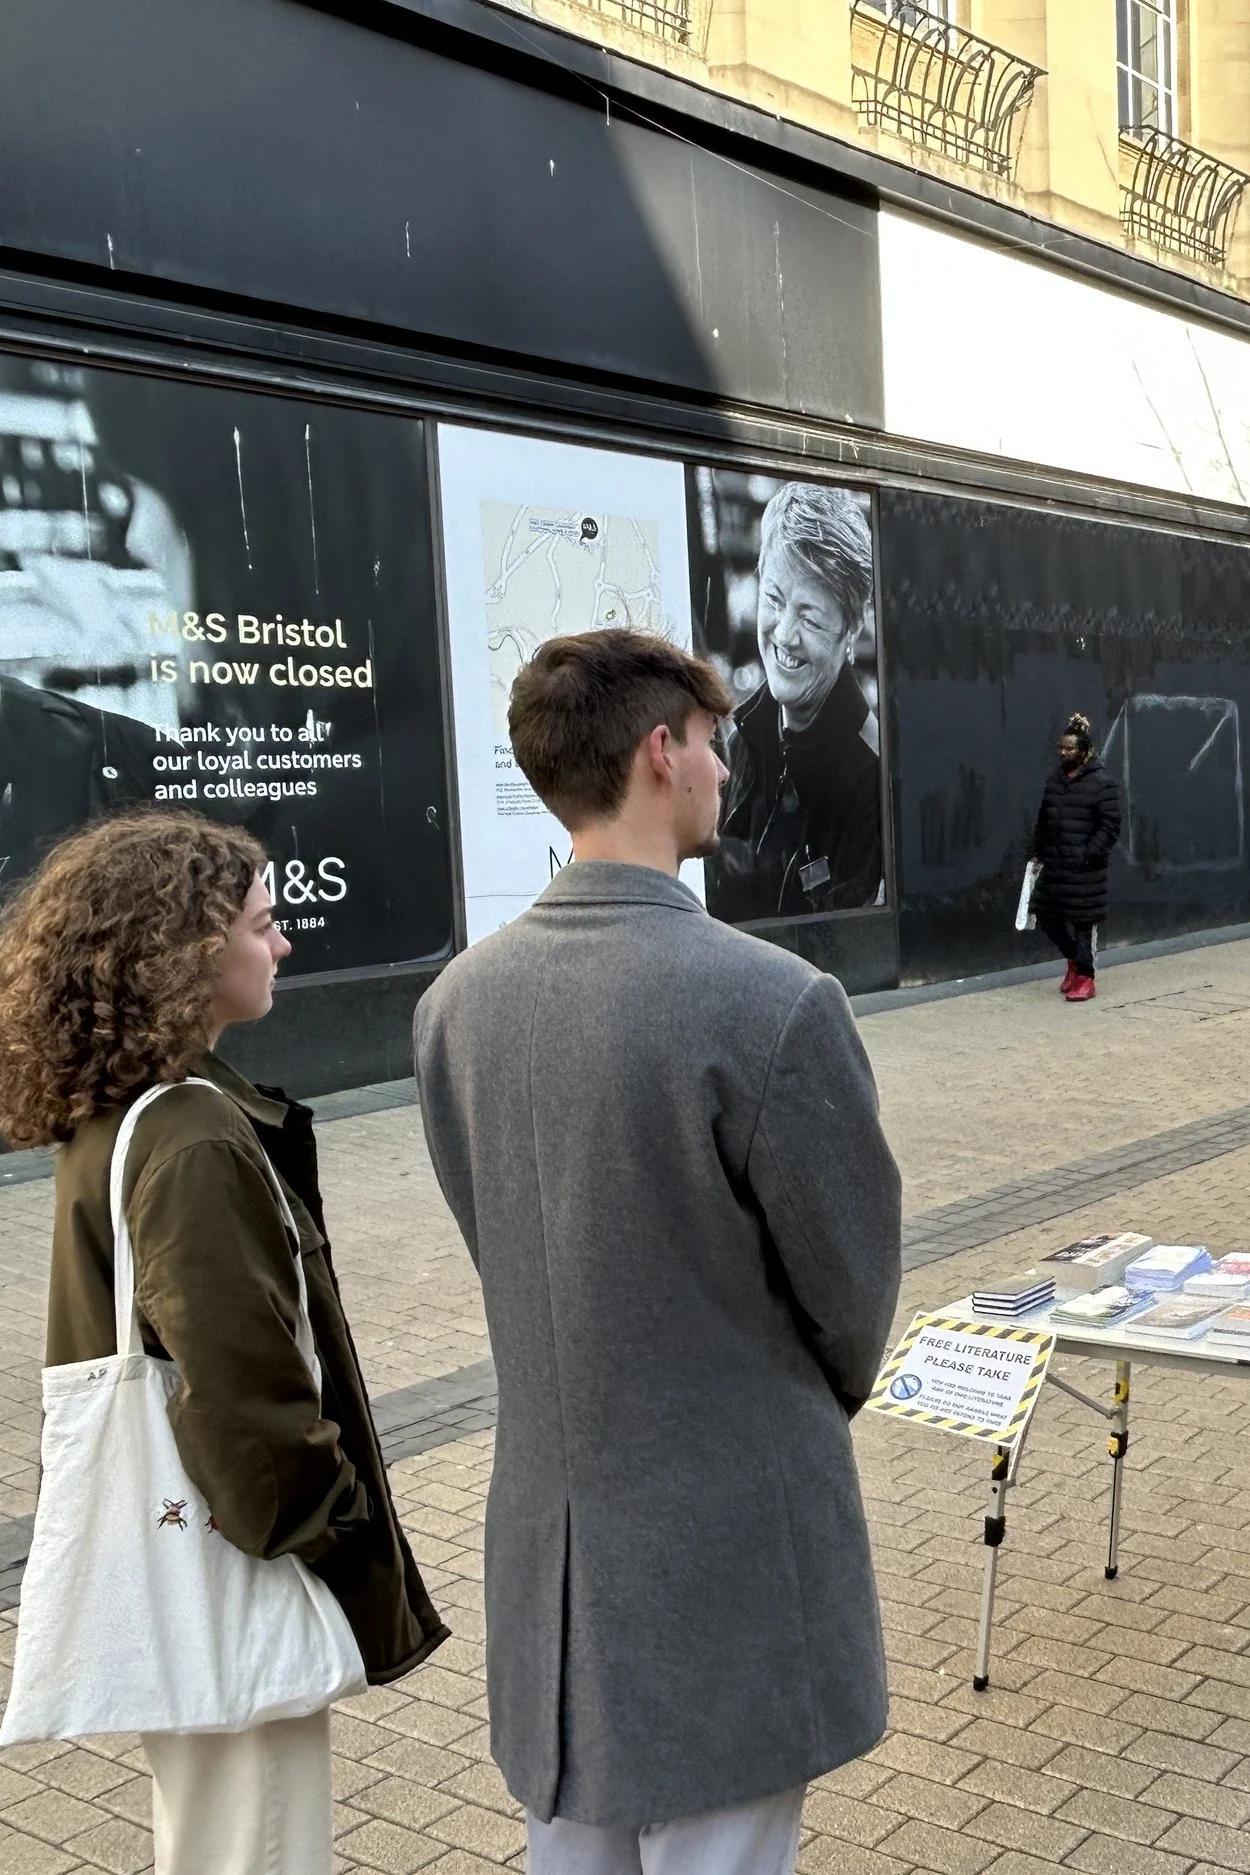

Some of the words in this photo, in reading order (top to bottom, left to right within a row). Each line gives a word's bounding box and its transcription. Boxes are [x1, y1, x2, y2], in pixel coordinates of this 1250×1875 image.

[150, 611, 227, 644] M&S
[237, 613, 348, 649] Bristol
[150, 652, 178, 683] is
[189, 660, 260, 685] now
[269, 656, 374, 688] closed
[155, 722, 222, 742] Thank
[225, 726, 266, 747] you
[270, 723, 293, 742] to
[298, 722, 325, 742] all
[153, 754, 193, 771] our
[197, 750, 252, 775] loyal
[256, 751, 362, 769] customers
[154, 779, 197, 799] and
[203, 778, 318, 801] colleagues
[296, 916, 326, 930] 1884
[919, 1336, 953, 1350] FREE
[954, 1343, 1033, 1366] LITERATURE
[924, 1355, 975, 1375] PLEASE
[977, 1366, 1012, 1382] TAKE
